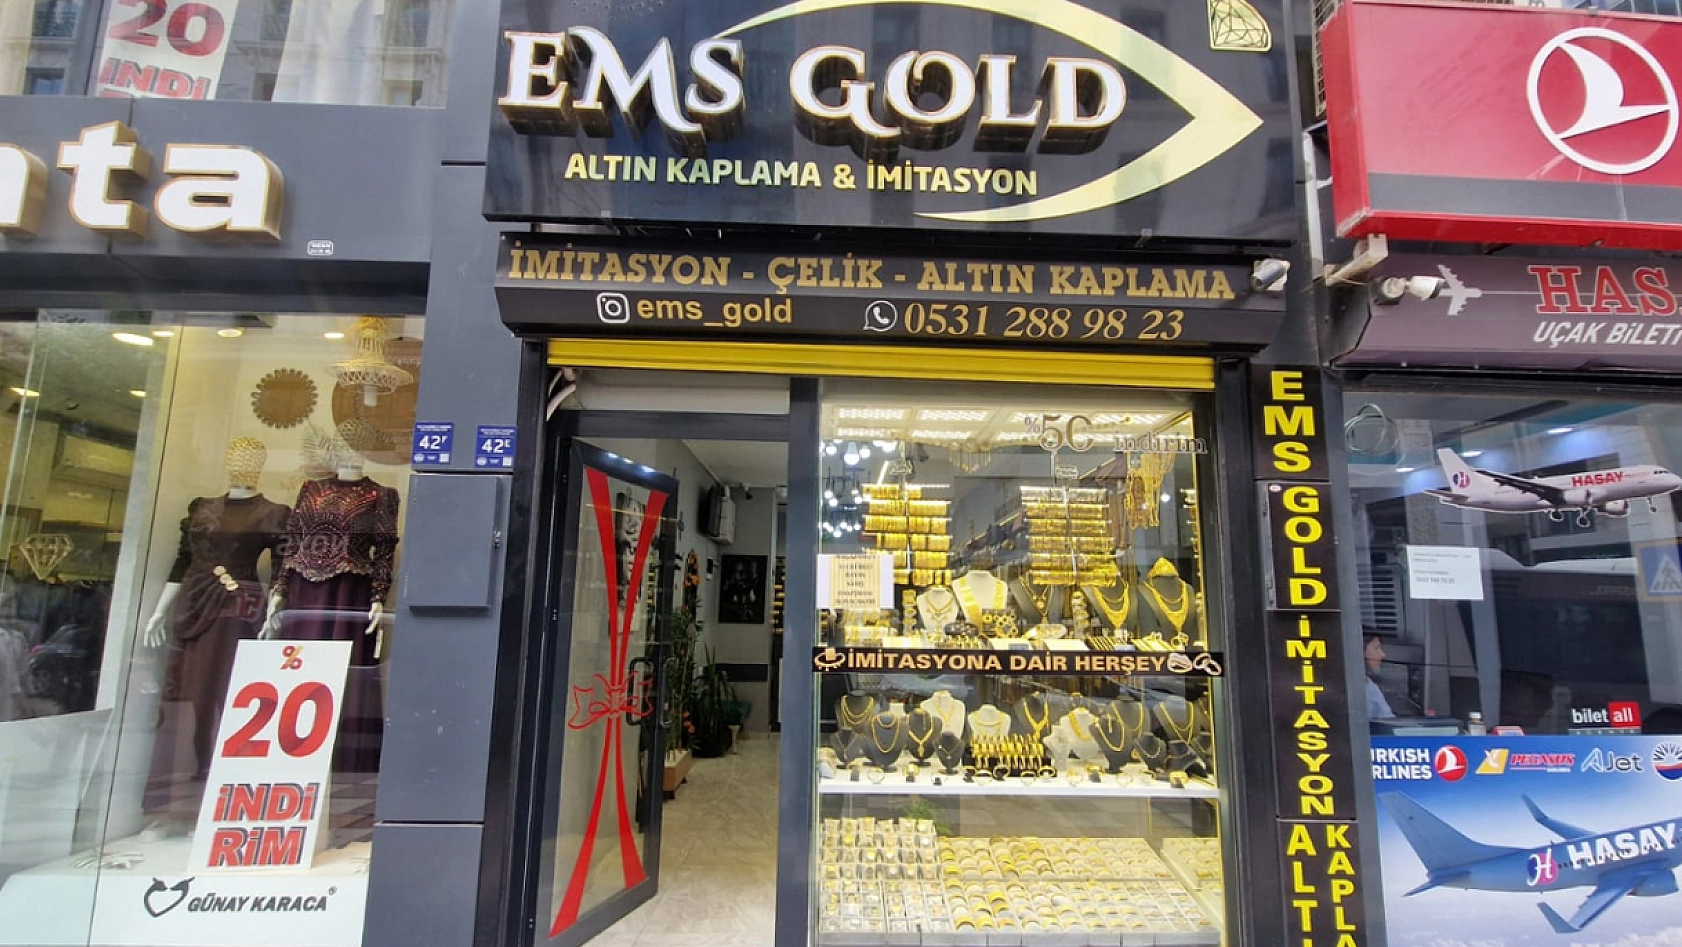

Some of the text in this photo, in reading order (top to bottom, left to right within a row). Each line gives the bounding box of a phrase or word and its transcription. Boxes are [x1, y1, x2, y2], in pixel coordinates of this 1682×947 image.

[108, 0, 224, 56] 20
[498, 26, 1128, 138] EMS GOLD
[565, 152, 1037, 196] ALTIN KAPLAMA & İMİTASYON
[508, 240, 732, 287] İMİTASYON
[767, 253, 884, 295] ÇELİK
[917, 261, 1036, 294] ALTIN
[1049, 266, 1236, 300] KAPLAMA
[1527, 264, 1682, 317] HAS
[636, 297, 793, 329] ems_gold
[904, 302, 1185, 342] 0531 288 98 23
[1533, 321, 1604, 349] UÇAK
[1263, 370, 1316, 473] EMS
[1571, 471, 1624, 487] HASAY
[1282, 486, 1328, 606] GOLD
[280, 645, 304, 670] %
[847, 648, 1165, 676] İMİTASYONA DAİR HERŞEY
[221, 681, 334, 758] 20
[1571, 707, 1635, 724] bilet all
[1510, 753, 1576, 767] PEGASUS
[1566, 822, 1677, 871] HASAY
[187, 892, 327, 912] GÜNAY KARACA
